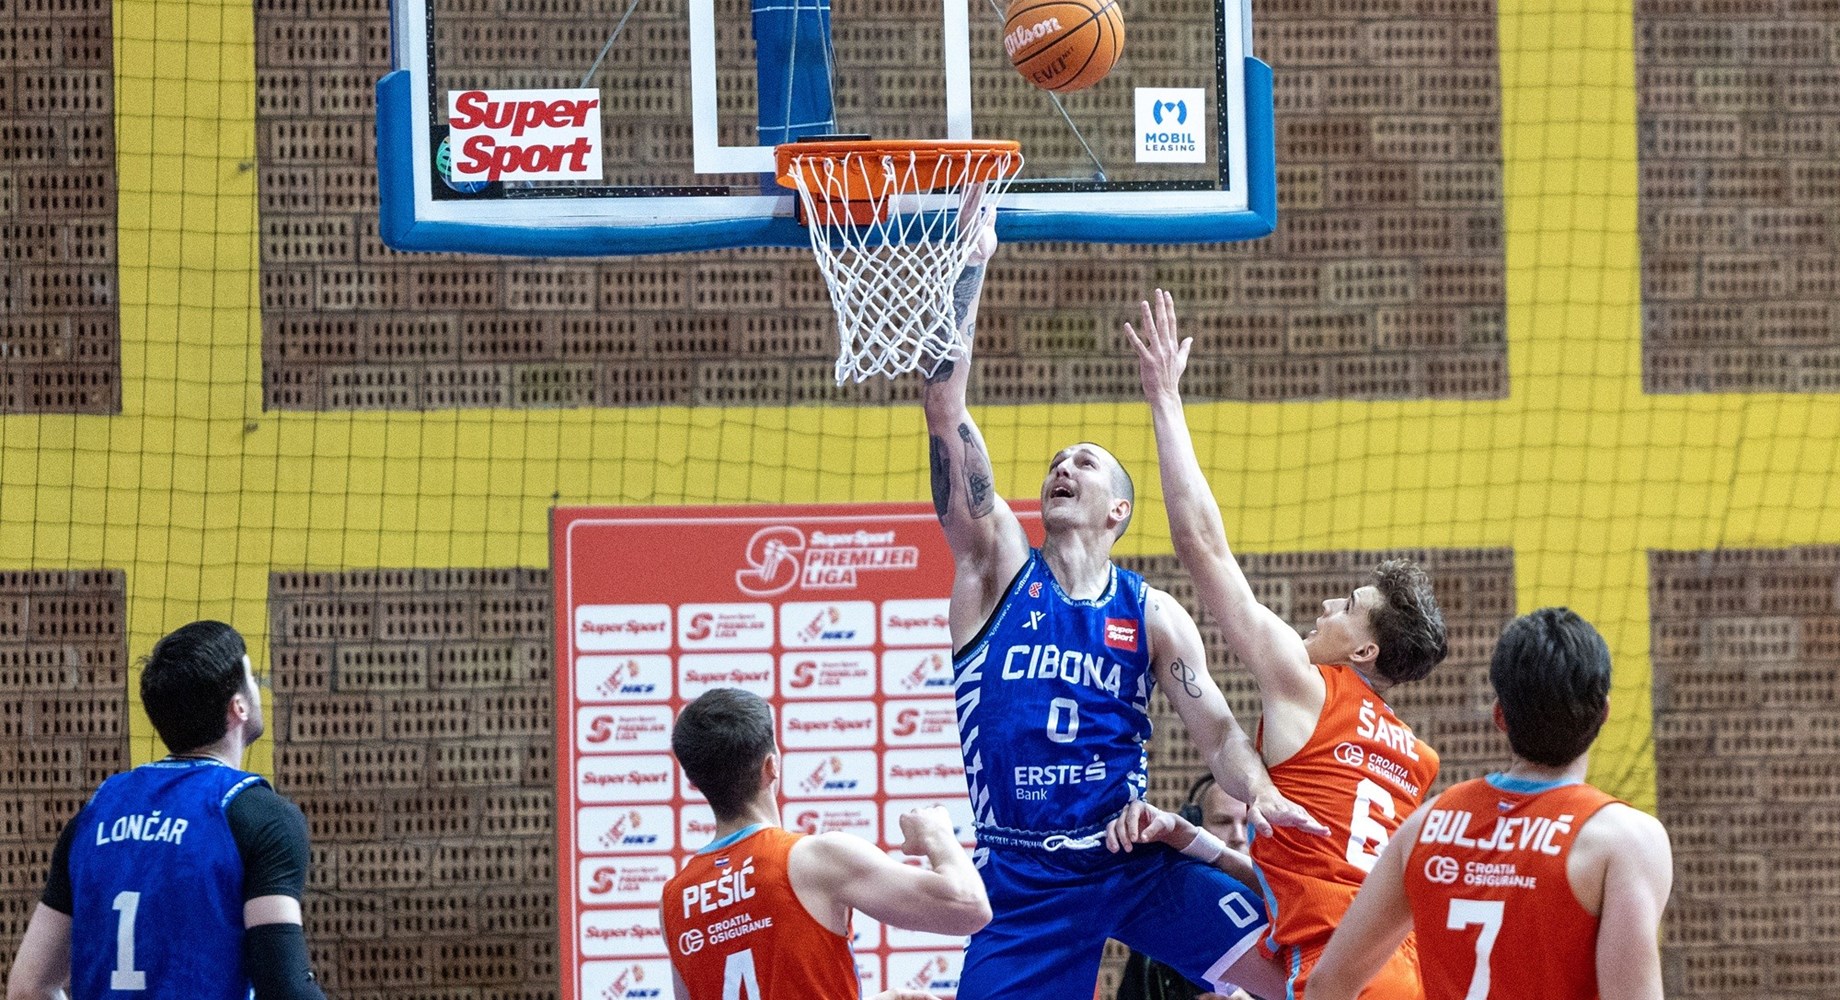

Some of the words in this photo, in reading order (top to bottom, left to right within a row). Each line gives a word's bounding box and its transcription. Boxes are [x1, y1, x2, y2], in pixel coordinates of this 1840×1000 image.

[1004, 17, 1062, 57] Wilson
[449, 90, 599, 136] Super
[1145, 133, 1196, 144] MOBIL
[1145, 144, 1196, 152] LEASING
[456, 135, 592, 182] Sport
[808, 549, 915, 567] PREMIJER
[804, 568, 853, 584] LIGA
[580, 619, 667, 635] SuperSport
[1106, 624, 1136, 634] Super
[1107, 632, 1134, 642] Sport
[685, 669, 770, 684] SuperSport
[1001, 644, 1122, 699] CIBONA
[787, 718, 872, 733] SuperSport
[1046, 697, 1079, 743] 0
[1356, 699, 1420, 762] ŠARE
[582, 770, 668, 786] SuperSport
[1014, 764, 1084, 786] ERSTE
[1368, 752, 1408, 778] CROATIA
[1367, 764, 1419, 797] OSIGURANJE
[1016, 788, 1048, 801] Bank
[96, 810, 189, 846] LONČAR
[1345, 777, 1396, 874] 6
[1419, 809, 1575, 856] BULJEVIĆ
[1465, 861, 1516, 874] CROATIA
[682, 856, 756, 919] PEŠIĆ
[1463, 873, 1537, 889] OSIGURANJE
[1218, 891, 1259, 928] 0
[707, 913, 752, 935] CROATIA
[709, 917, 773, 945] OSIGURANJE
[110, 891, 147, 990] 1
[1446, 898, 1505, 1000] 7
